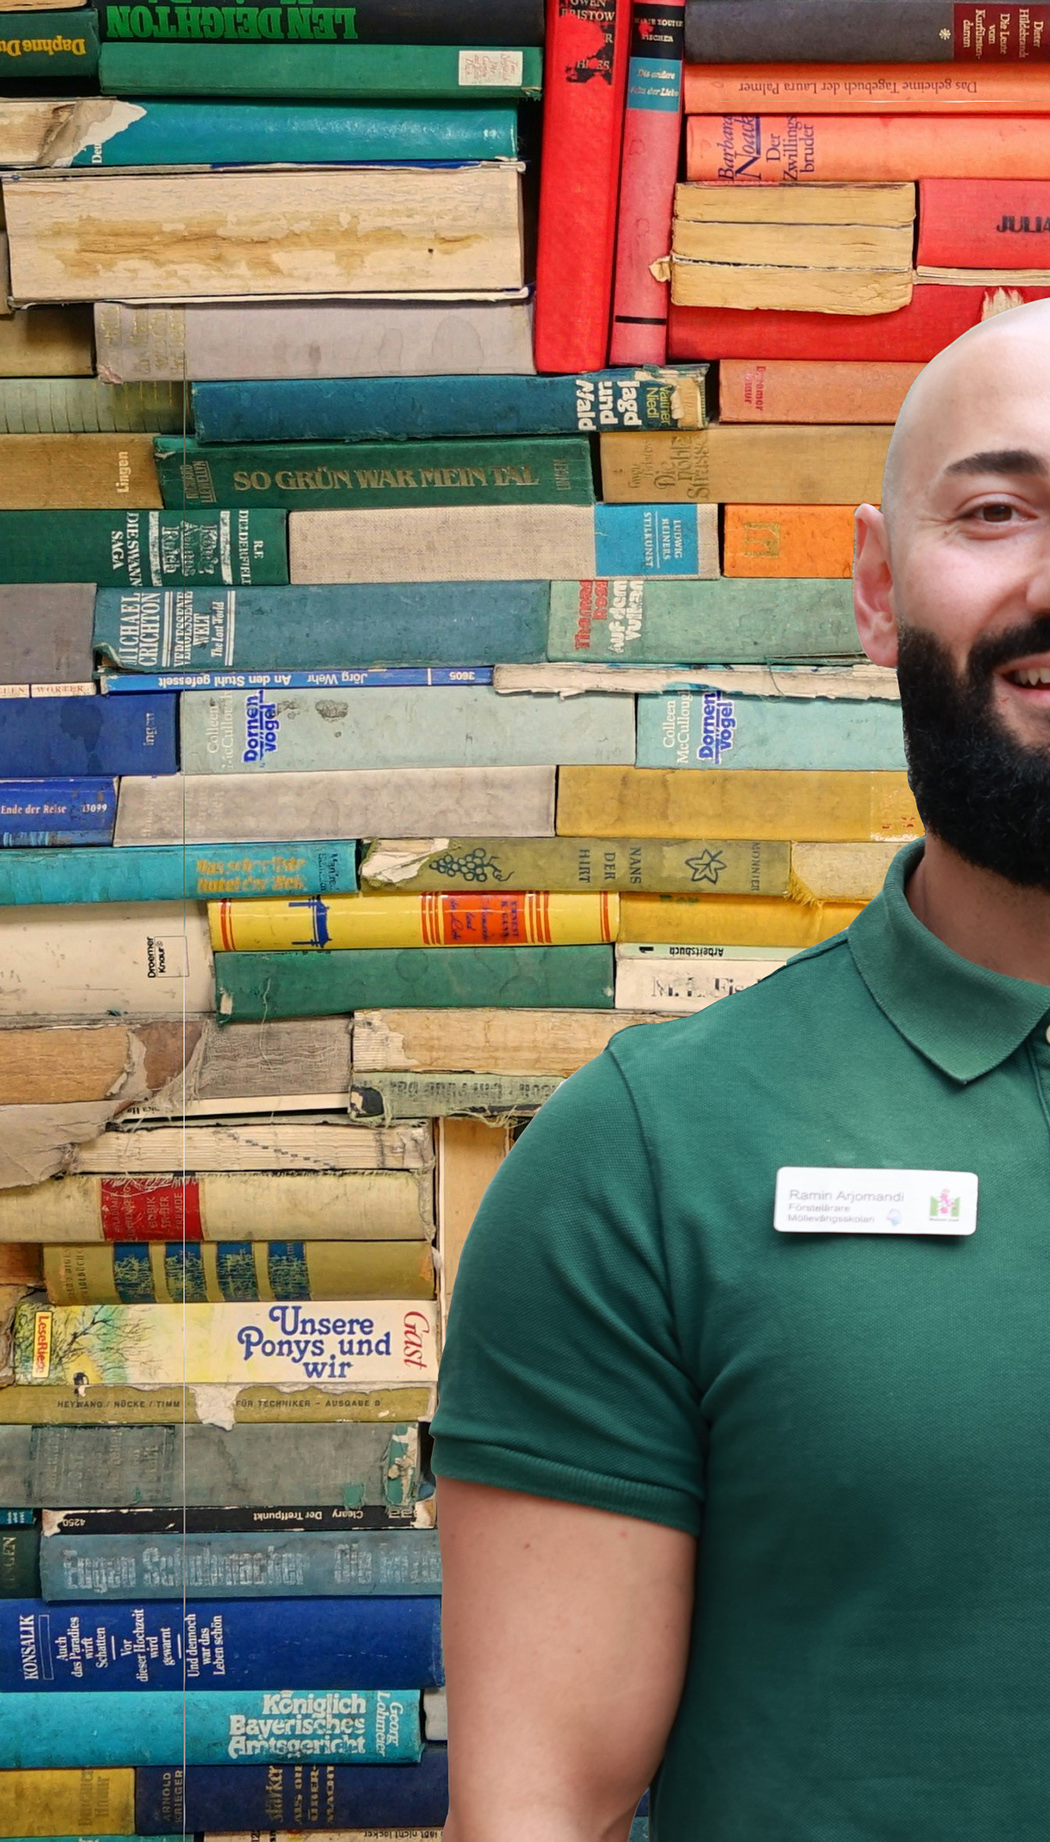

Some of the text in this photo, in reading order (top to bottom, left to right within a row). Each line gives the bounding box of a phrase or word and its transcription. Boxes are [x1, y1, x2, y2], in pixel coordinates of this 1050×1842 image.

[106, 7, 358, 39] LEN DEIGHTON
[23, 38, 86, 56] Daphne
[738, 79, 978, 95] Das geheime Tagebuch der Laura Palmer
[718, 115, 735, 181] Barbara
[735, 113, 762, 181] Noack
[766, 133, 781, 162] Der
[800, 124, 815, 173] bruder
[575, 379, 597, 431] Wald
[617, 379, 643, 427] Jagd
[116, 451, 130, 494] Lingen
[233, 464, 539, 491] SO GRÜN WAR MEIN TAL
[110, 530, 125, 571] SAGA
[661, 518, 672, 561] REINERS
[673, 519, 683, 559] LUDWIG
[138, 592, 162, 667] CRICHTON
[192, 612, 211, 647] WELT
[158, 671, 368, 689] gefesselt Stuhl den An Wehr Jörg
[243, 693, 260, 763] Dornen
[662, 699, 676, 748] Colleen
[697, 691, 716, 759] Dornen
[1, 804, 40, 815] Ende der
[577, 848, 591, 884] HIRT
[604, 852, 616, 880] DER
[629, 846, 642, 885] NANS
[146, 936, 156, 979] Droemer
[668, 948, 724, 957] Arbeitsbuch
[788, 1189, 905, 1204] Ramin Arjomandi
[268, 1305, 375, 1336] Unsere
[402, 1309, 431, 1370] Gast
[237, 1325, 392, 1364] Ponys und
[303, 1355, 353, 1379] wir
[253, 1508, 364, 1522] Cleary Der Treffpunkt
[20, 1614, 39, 1681] KONSALIK
[55, 1635, 69, 1662] Auch
[67, 1616, 84, 1678] das Paradies
[82, 1636, 95, 1660] wirft
[95, 1626, 109, 1669] Schatten
[120, 1639, 134, 1657] Vor
[132, 1608, 150, 1683] dieser Hochzeit
[146, 1635, 159, 1659] wird
[161, 1626, 176, 1667] gewarnt
[184, 1613, 200, 1678] Und dennoch
[198, 1627, 212, 1666] war das
[210, 1615, 227, 1676] Leben schön
[262, 1690, 367, 1718] Königlich
[228, 1713, 366, 1739] Bayerisches
[227, 1734, 367, 1760] Amtsgericht
